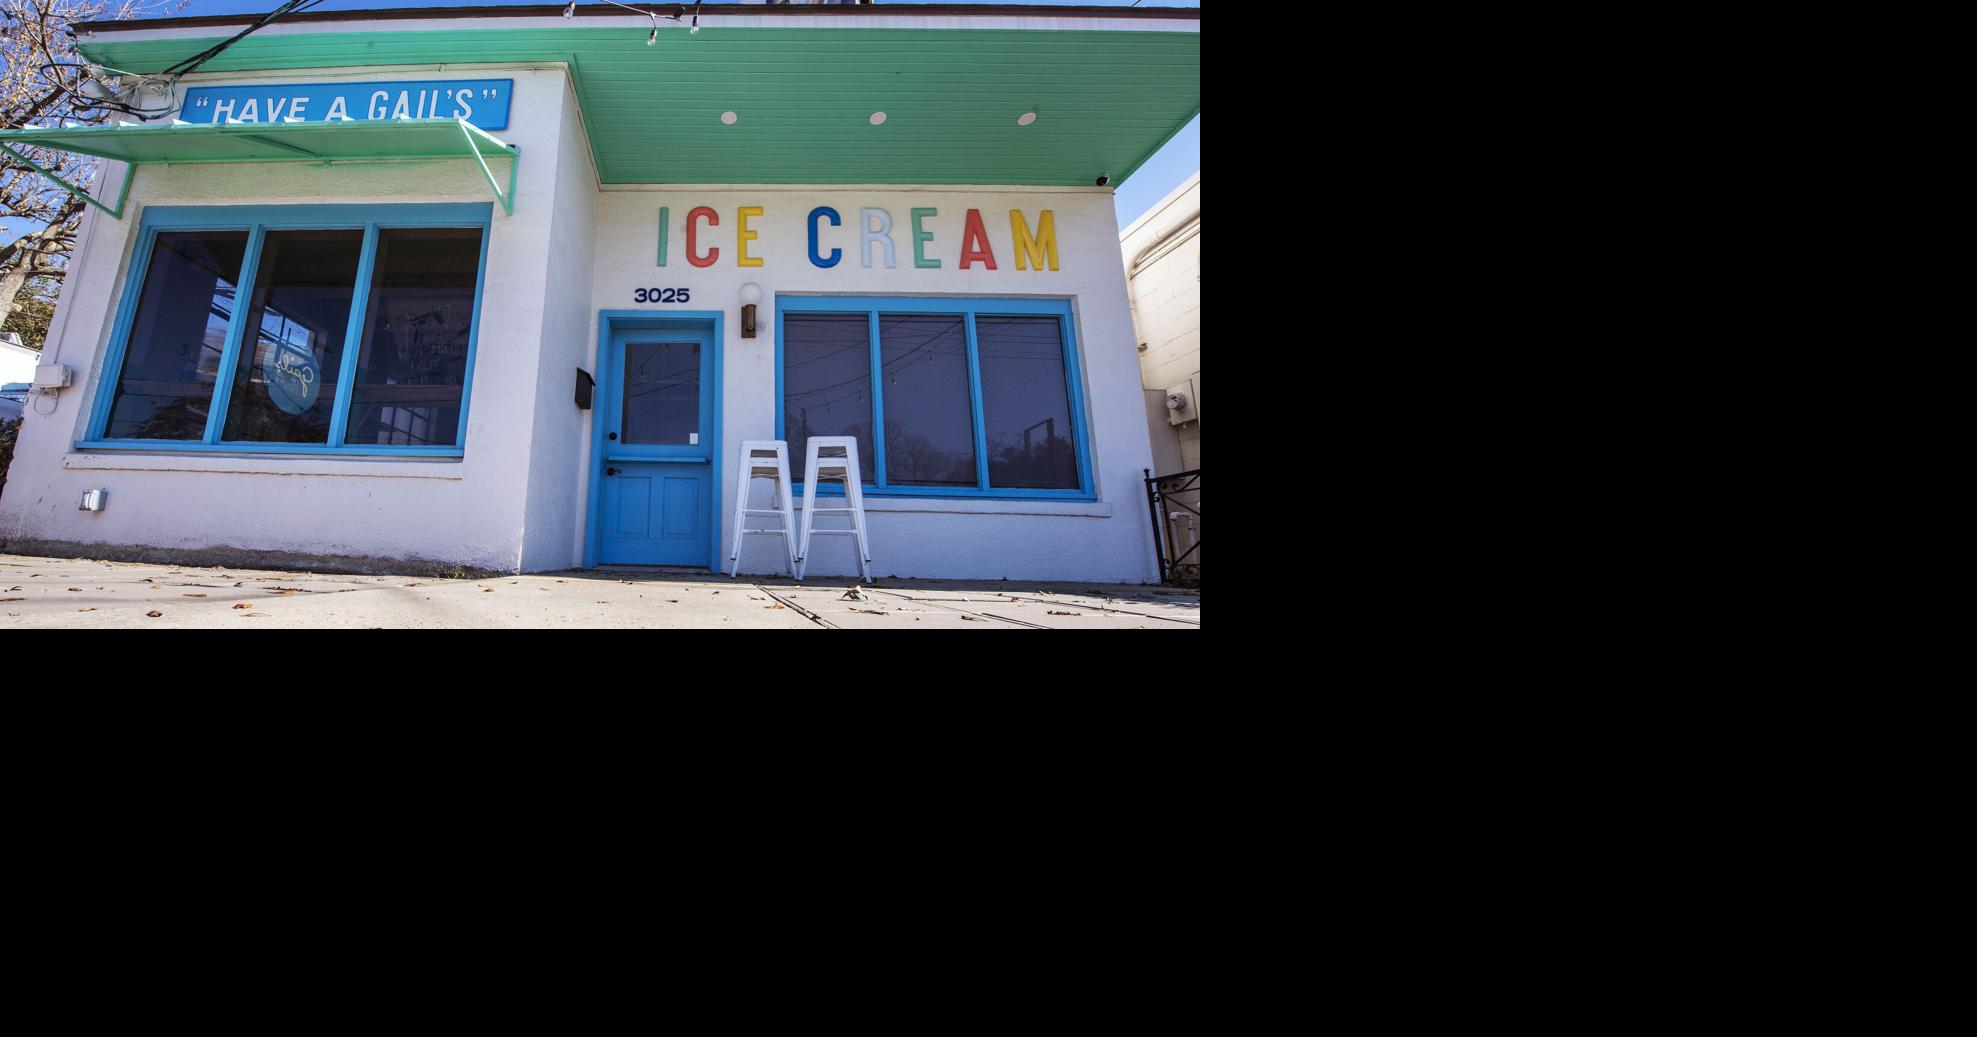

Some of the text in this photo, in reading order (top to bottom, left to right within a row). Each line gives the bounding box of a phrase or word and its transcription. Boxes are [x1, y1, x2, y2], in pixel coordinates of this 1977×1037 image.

[324, 96, 348, 121] A
[657, 205, 1060, 271] ICE CREAM
[633, 287, 690, 303] 3025
